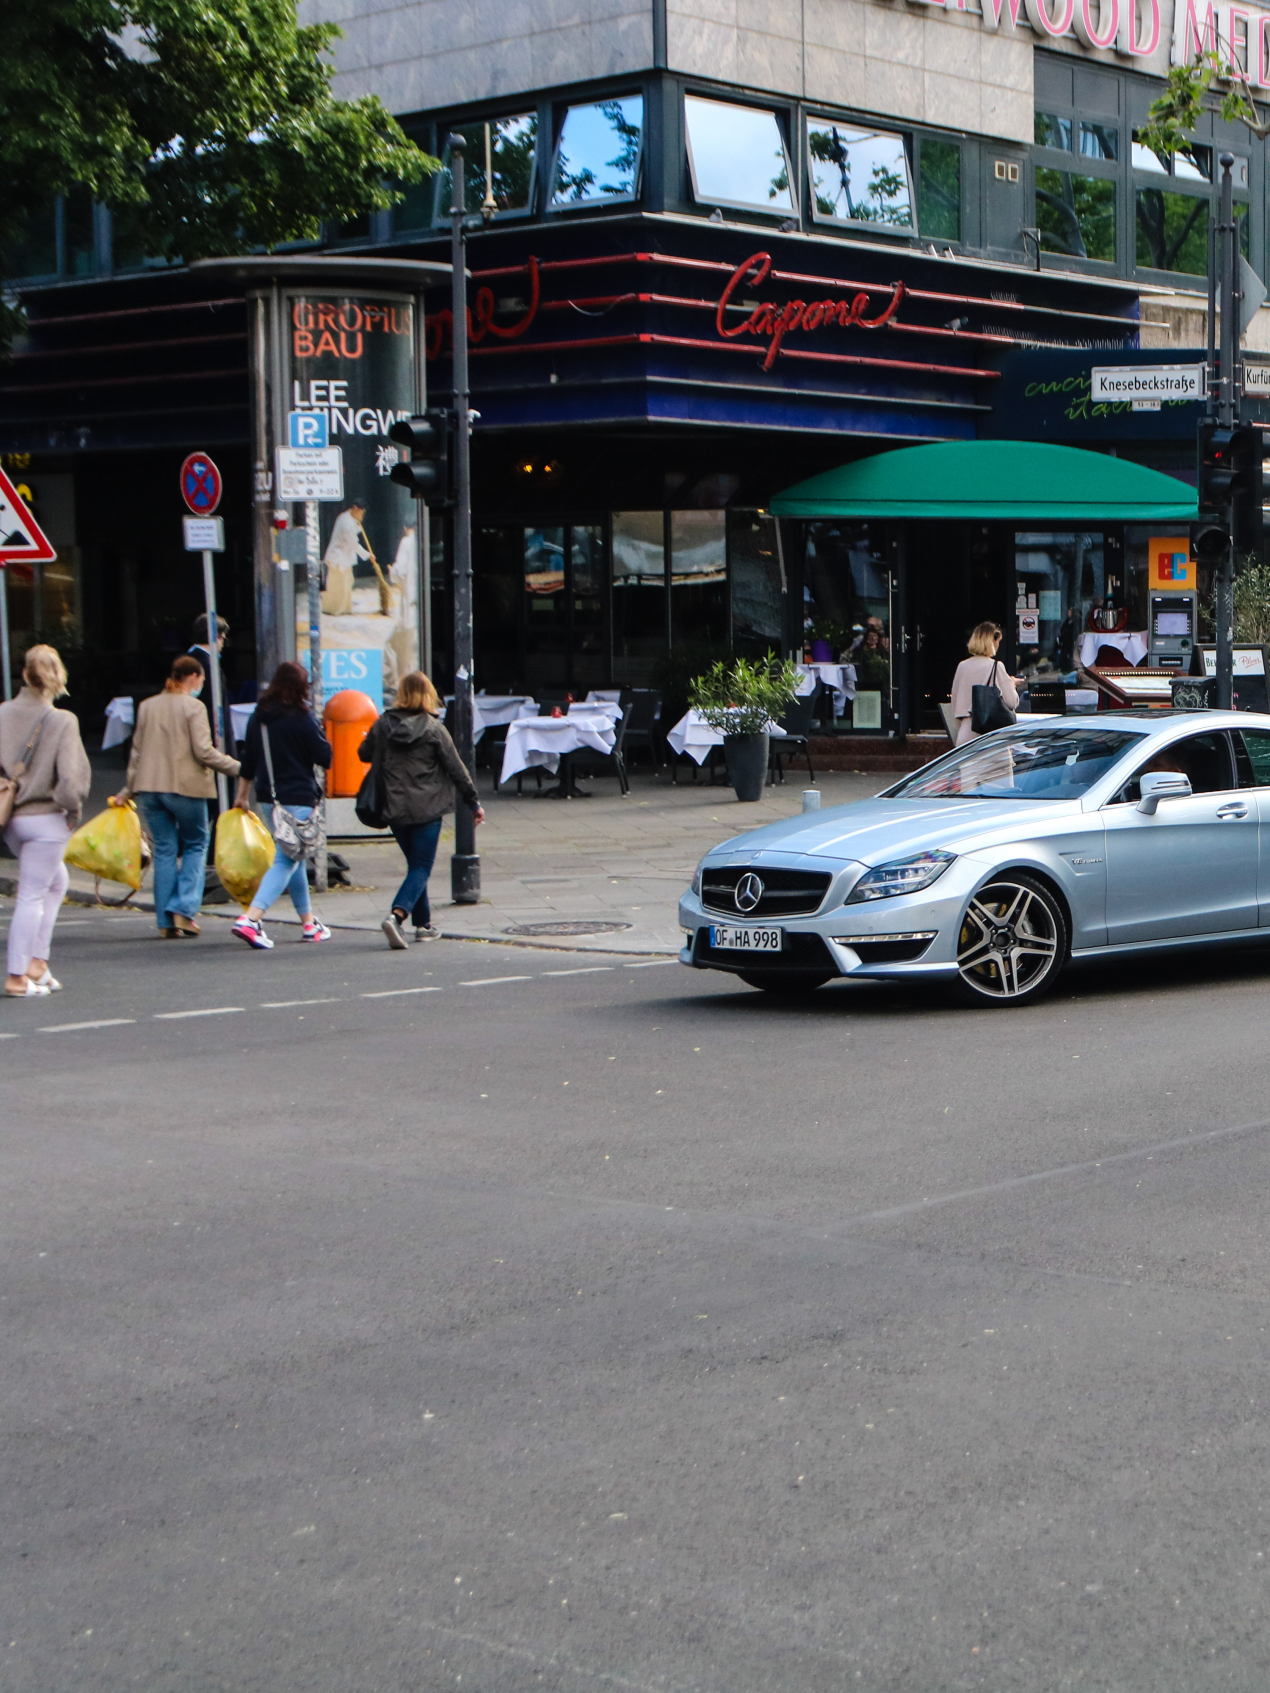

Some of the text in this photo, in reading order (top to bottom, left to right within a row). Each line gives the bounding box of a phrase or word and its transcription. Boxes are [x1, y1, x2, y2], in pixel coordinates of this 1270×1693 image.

[716, 250, 906, 372] Capone
[294, 330, 364, 358] BAU
[294, 380, 349, 407] LEE
[1100, 377, 1196, 393] Knesebeckstraße
[716, 929, 778, 949] OF HA 998
